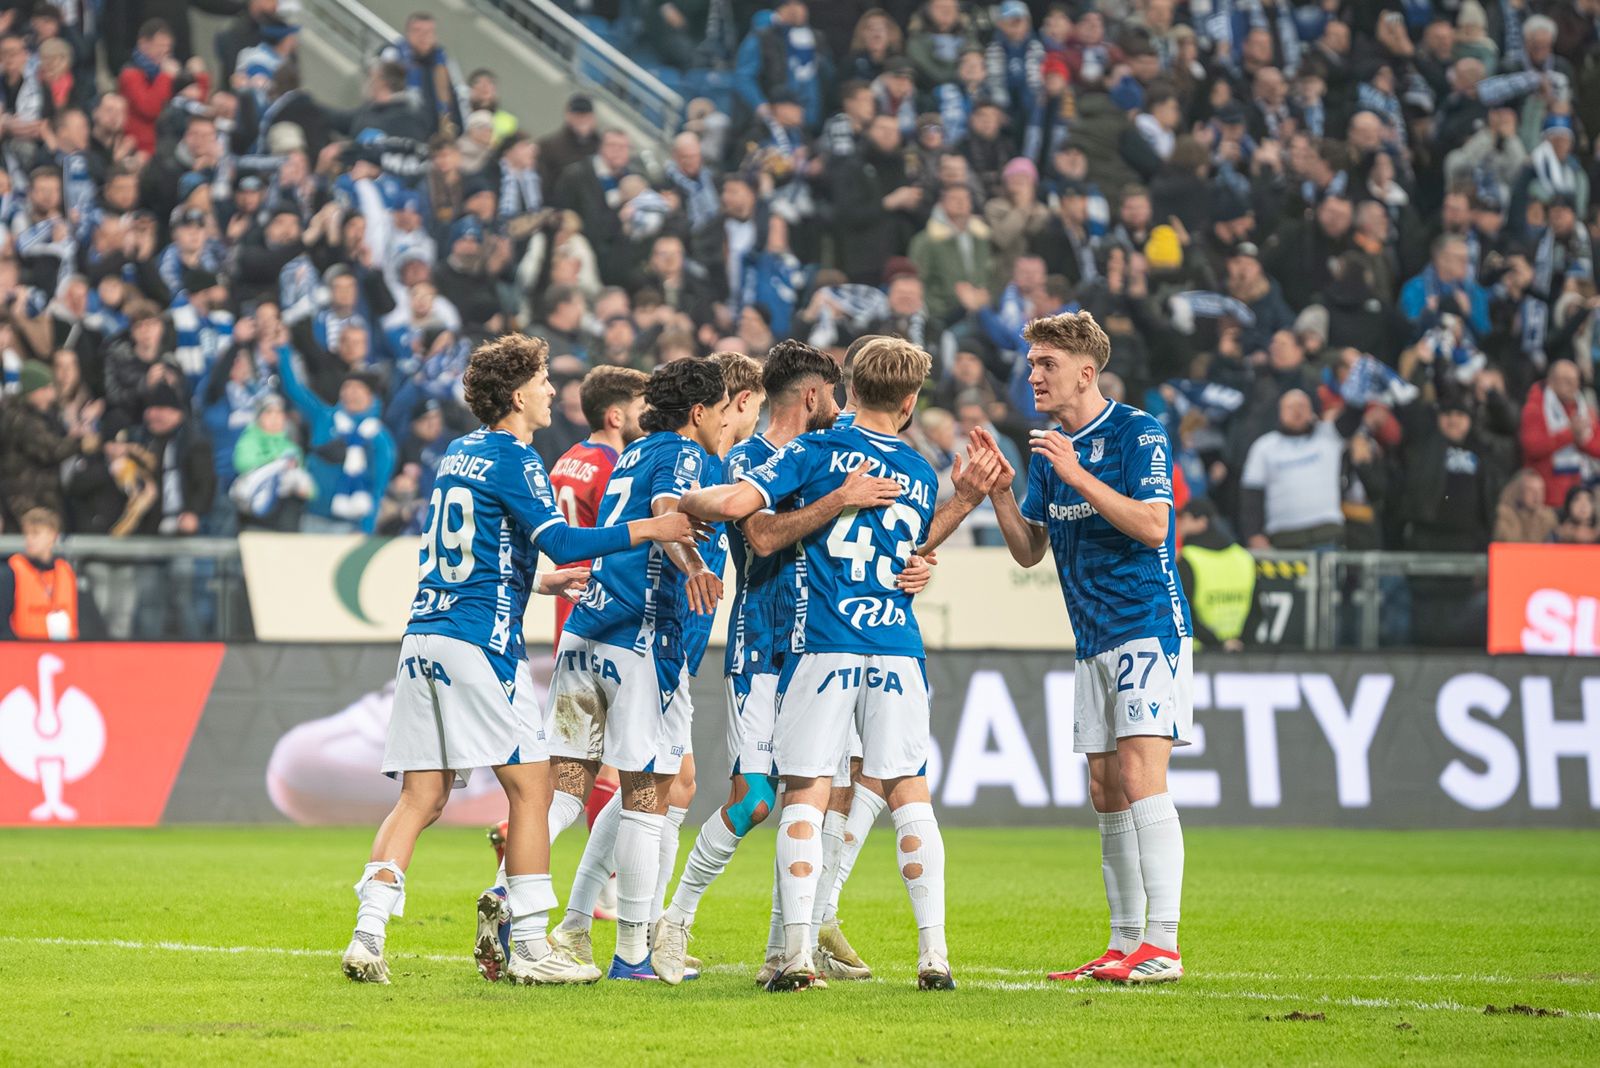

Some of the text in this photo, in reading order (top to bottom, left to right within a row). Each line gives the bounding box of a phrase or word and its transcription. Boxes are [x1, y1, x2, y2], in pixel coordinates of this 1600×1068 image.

[418, 486, 476, 583] 99
[826, 502, 922, 590] 43
[838, 596, 906, 630] Pils
[556, 649, 621, 685] TIGA
[1117, 651, 1159, 693] 27
